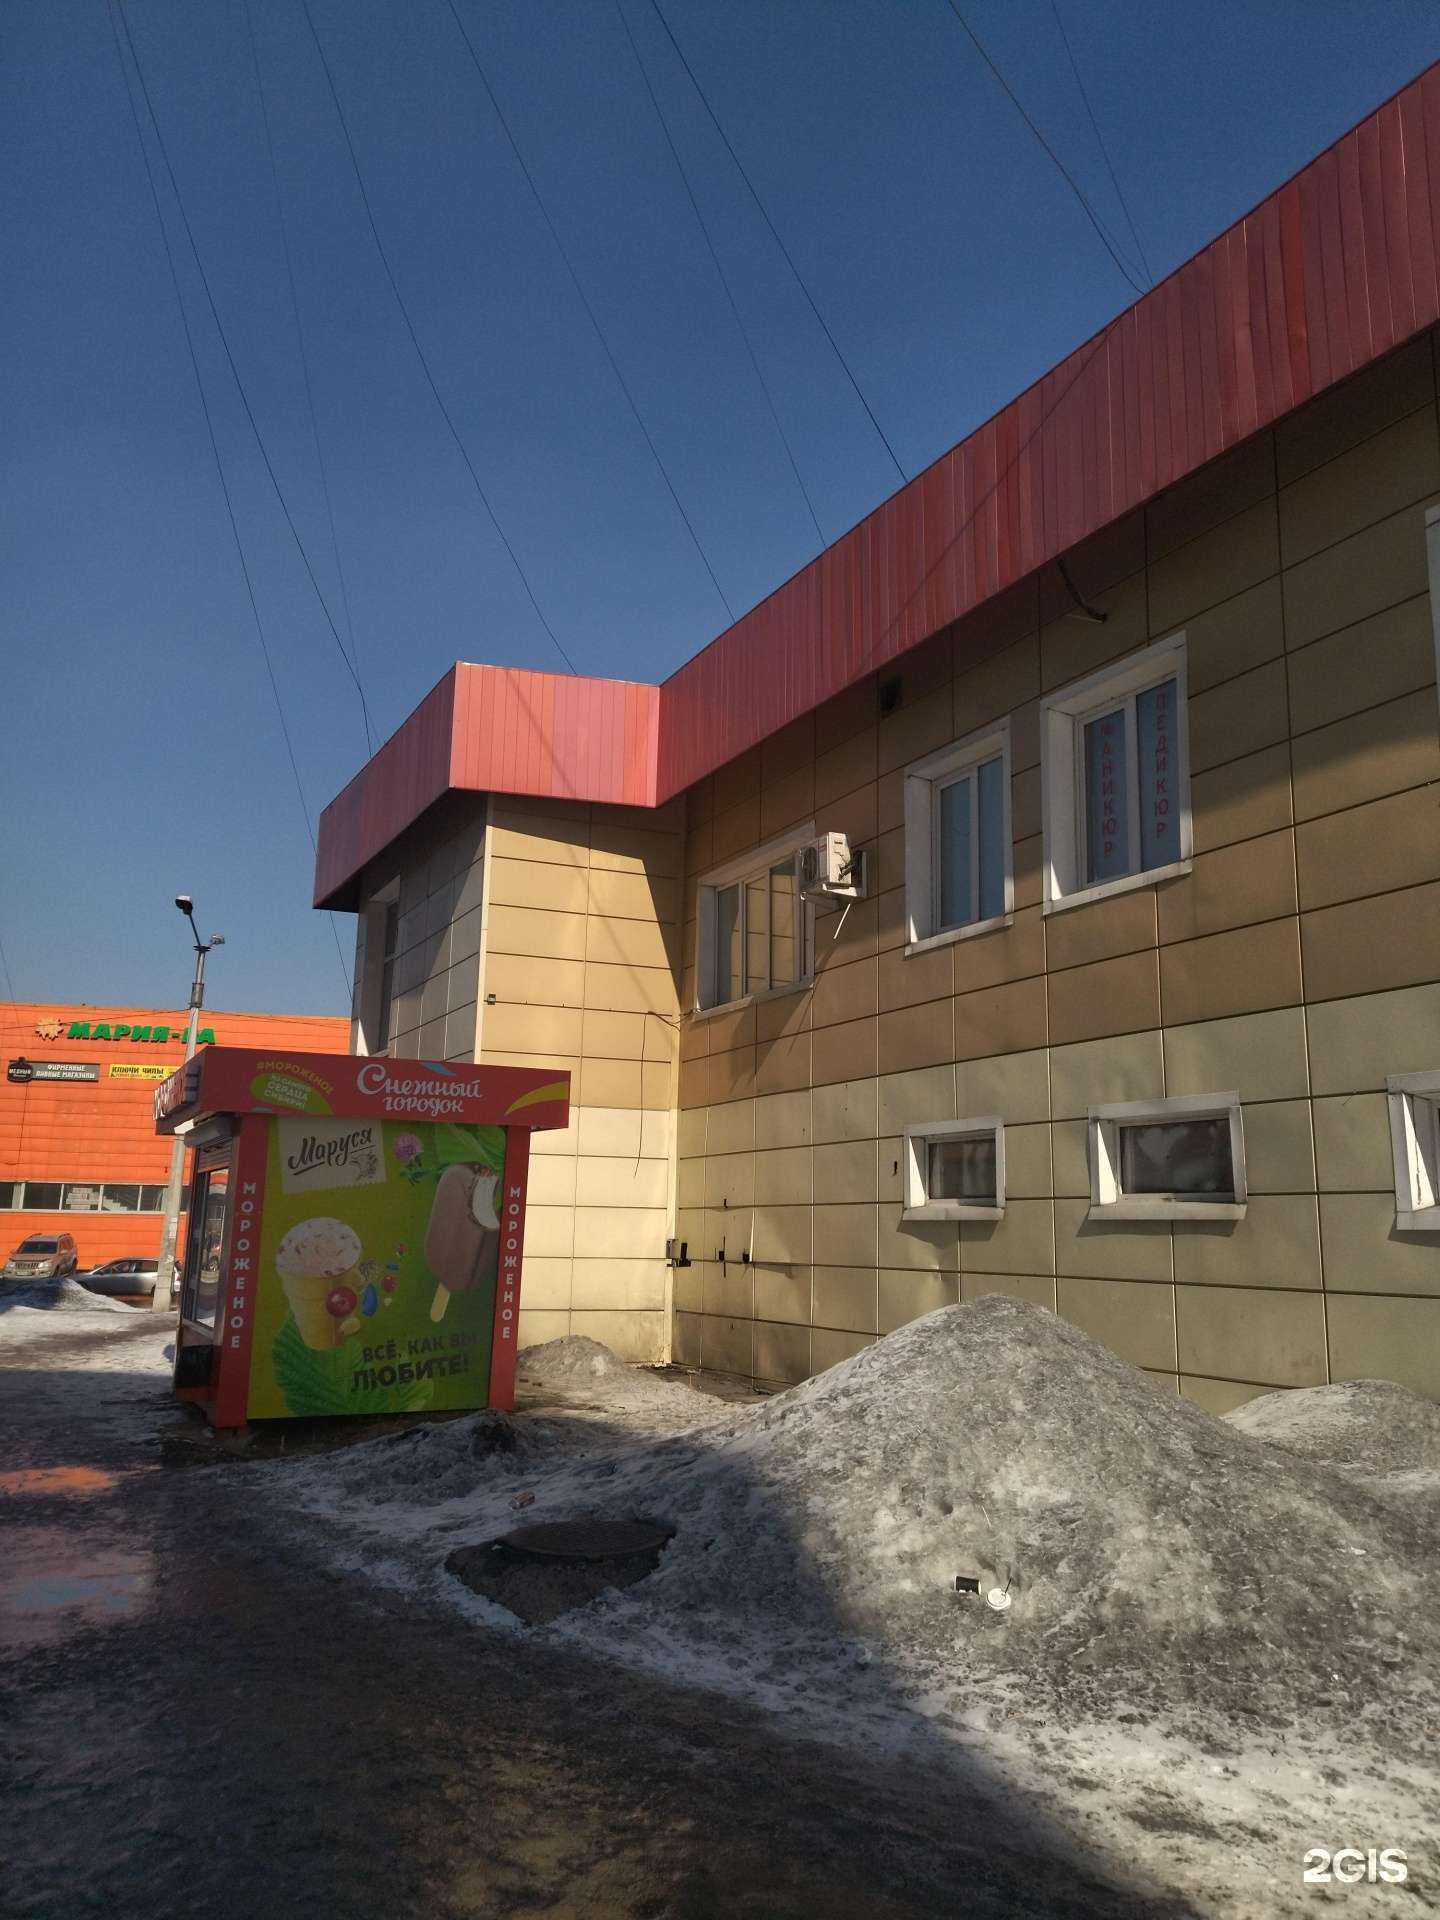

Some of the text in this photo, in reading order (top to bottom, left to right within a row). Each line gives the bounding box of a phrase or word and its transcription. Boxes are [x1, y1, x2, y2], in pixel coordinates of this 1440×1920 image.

[1154, 693, 1169, 838] ПЕДИКЮР
[1100, 720, 1117, 857] МАНИКЮР
[67, 1022, 216, 1045] МАРИЯ-А
[47, 1064, 86, 1072] ФИРМЕННЫЕ
[62, 1071, 95, 1079] МАГАЗИНЫ
[112, 1066, 139, 1074] КЛЮЧИ
[356, 1063, 484, 1099] Снежный
[382, 1094, 465, 1117] городок
[287, 1126, 376, 1170] Маруся
[230, 1181, 257, 1349] МОРОЖЕНОЕ
[501, 1185, 522, 1340] МОРОЖЕНОЕ
[407, 1336, 444, 1355] КАК
[448, 1332, 480, 1346] ВЫ
[351, 1354, 470, 1392] ЛЮБИТЕ!
